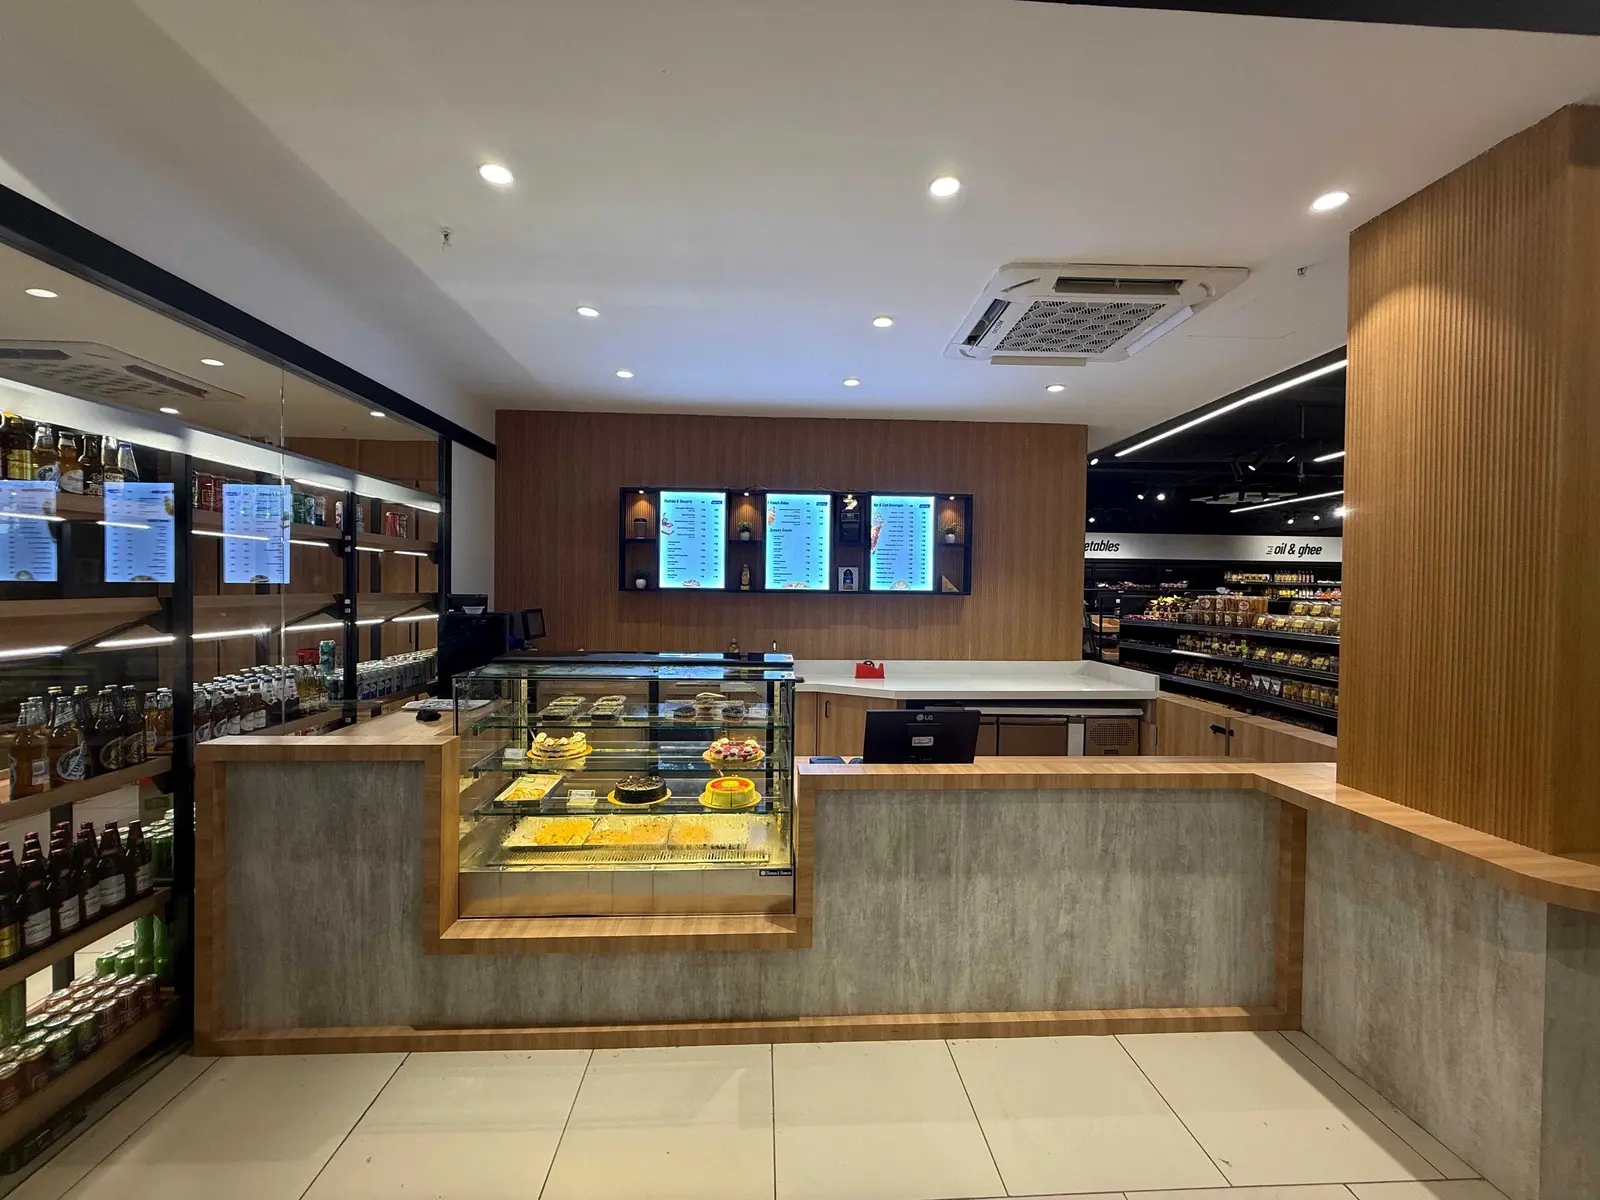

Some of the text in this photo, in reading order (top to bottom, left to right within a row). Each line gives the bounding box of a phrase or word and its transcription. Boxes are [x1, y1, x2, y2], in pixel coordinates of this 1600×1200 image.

[1084, 540, 1120, 552] etables
[1274, 542, 1322, 558] oil & ghee
